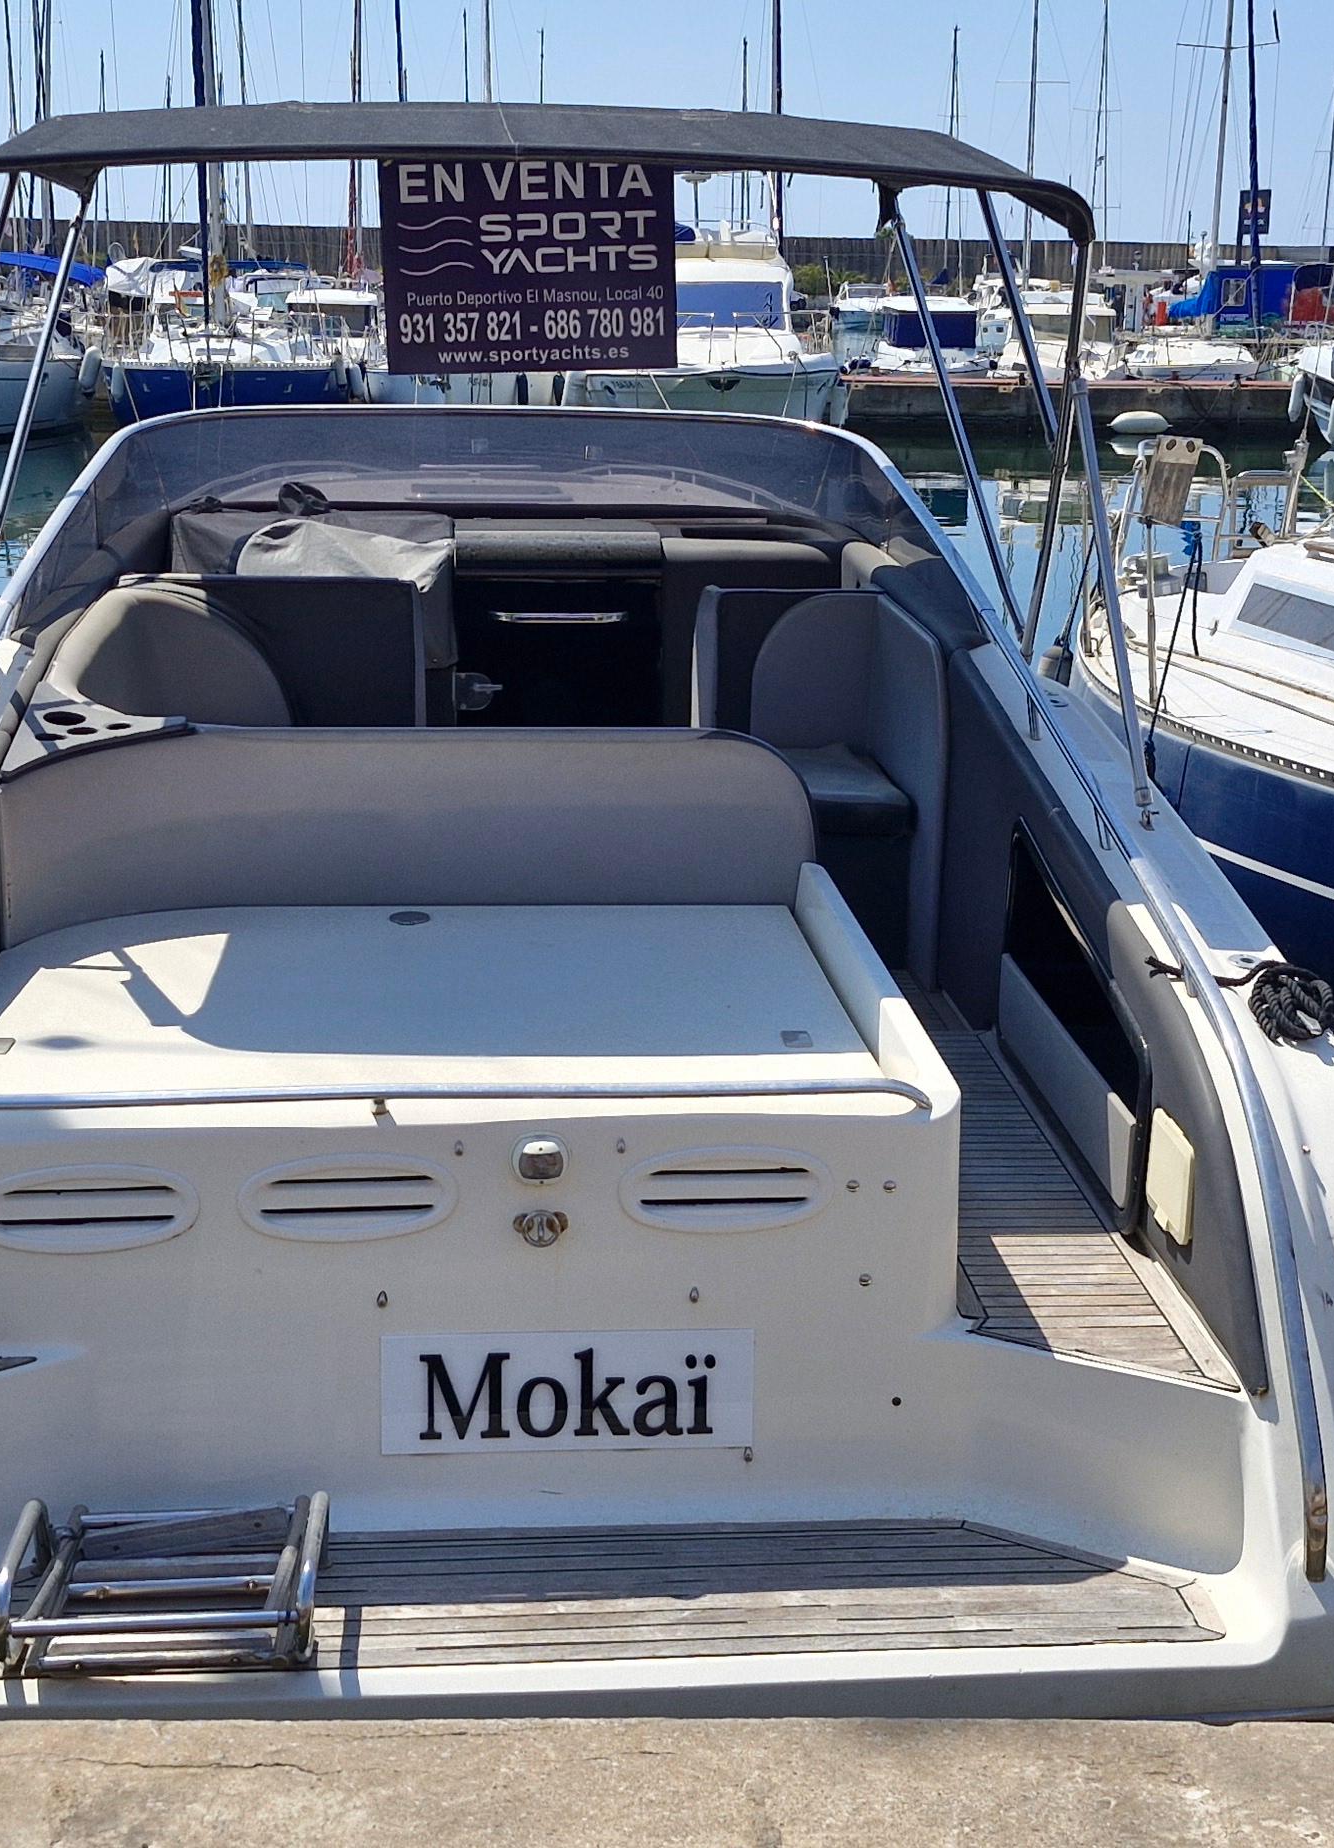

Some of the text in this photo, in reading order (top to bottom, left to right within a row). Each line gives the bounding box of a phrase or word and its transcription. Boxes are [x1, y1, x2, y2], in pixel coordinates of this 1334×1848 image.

[398, 161, 653, 204] EN VENTA
[479, 210, 657, 242] SPORT
[479, 244, 658, 274] YACHTS
[407, 285, 664, 307] Puerto Deportivo El Masnou, Local 40
[399, 312, 435, 344] 931
[443, 312, 479, 342] 357
[486, 310, 521, 341] 821
[544, 309, 581, 340] 686
[587, 308, 624, 338] 780
[630, 306, 665, 337] 981
[438, 345, 629, 366] www.sportyachts.es
[419, 1347, 717, 1441] Mokaï
